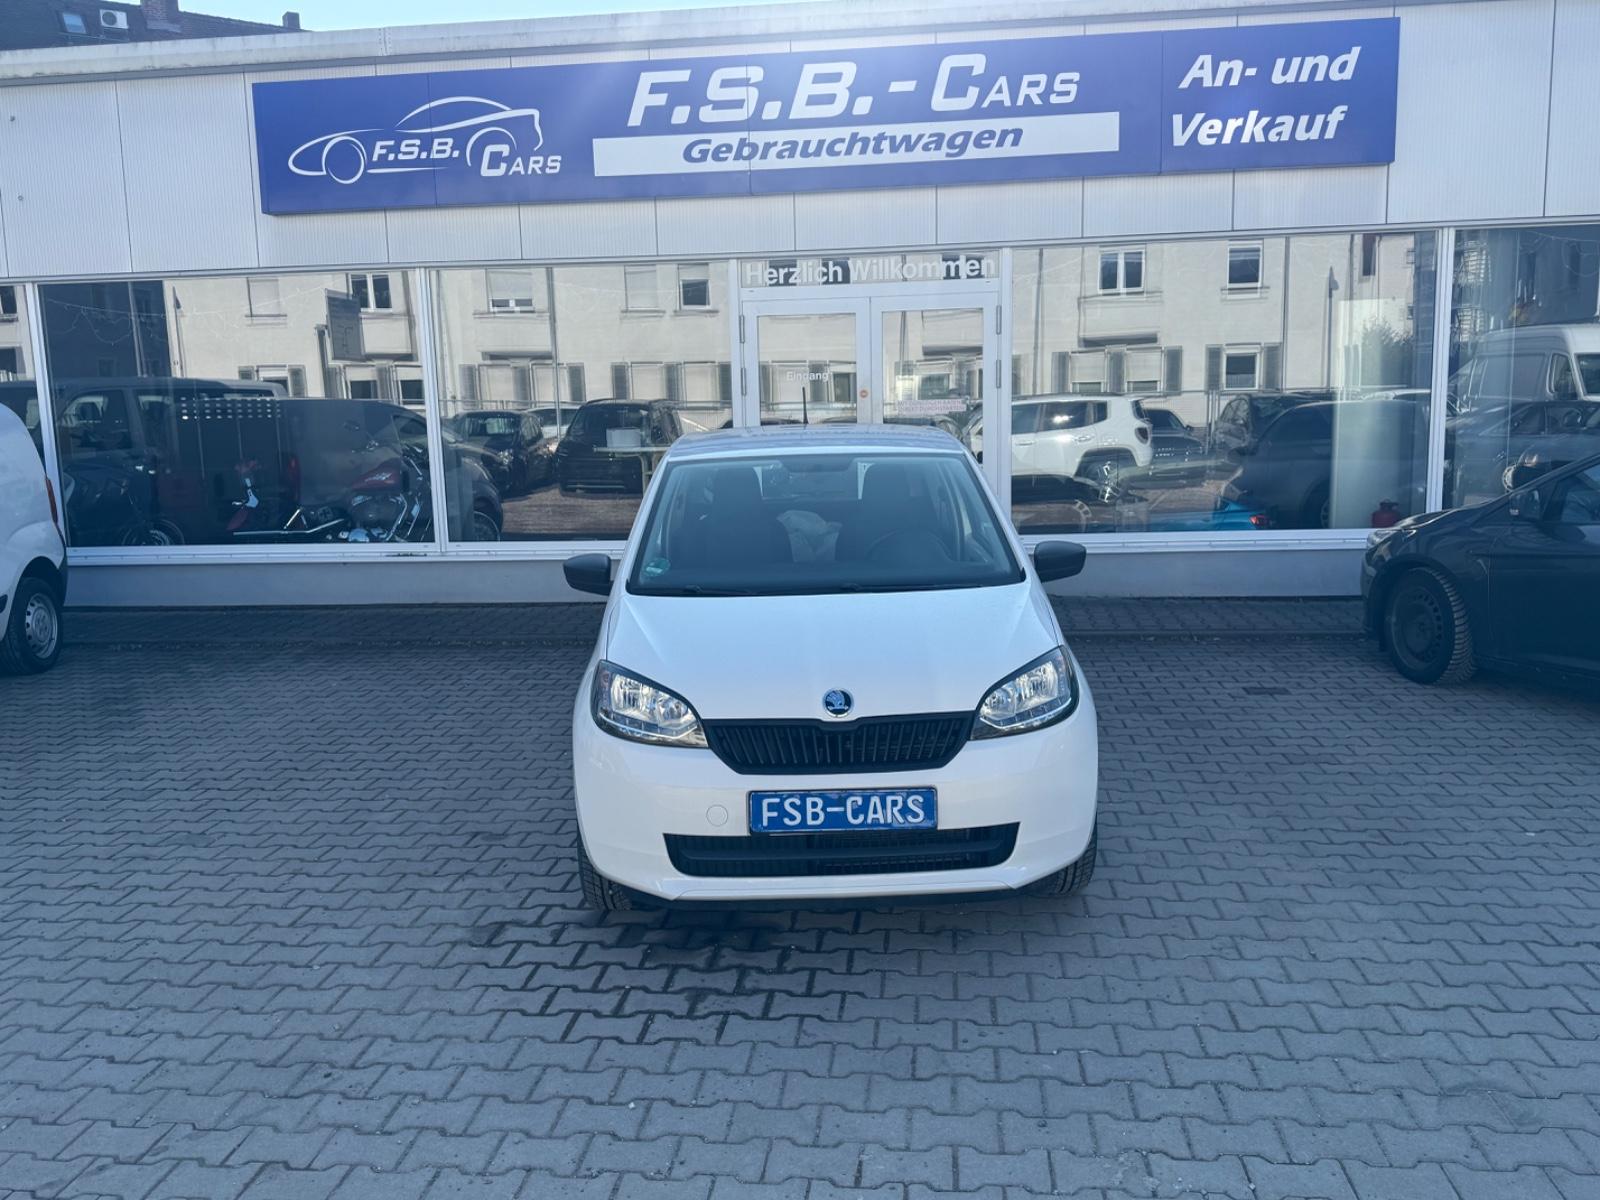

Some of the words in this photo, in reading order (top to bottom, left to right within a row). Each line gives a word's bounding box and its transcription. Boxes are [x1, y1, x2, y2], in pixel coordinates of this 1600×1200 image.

[1178, 54, 1257, 89] An-
[1271, 46, 1362, 85] und
[1172, 105, 1348, 147] Verkauf
[372, 138, 460, 162] F.S.B.
[682, 125, 1024, 163] Gebrauchtwagen
[746, 259, 843, 285] Herzlich
[848, 254, 995, 282] Willkommen
[786, 371, 829, 383] Eingang
[761, 795, 926, 827] FSB-CARS
